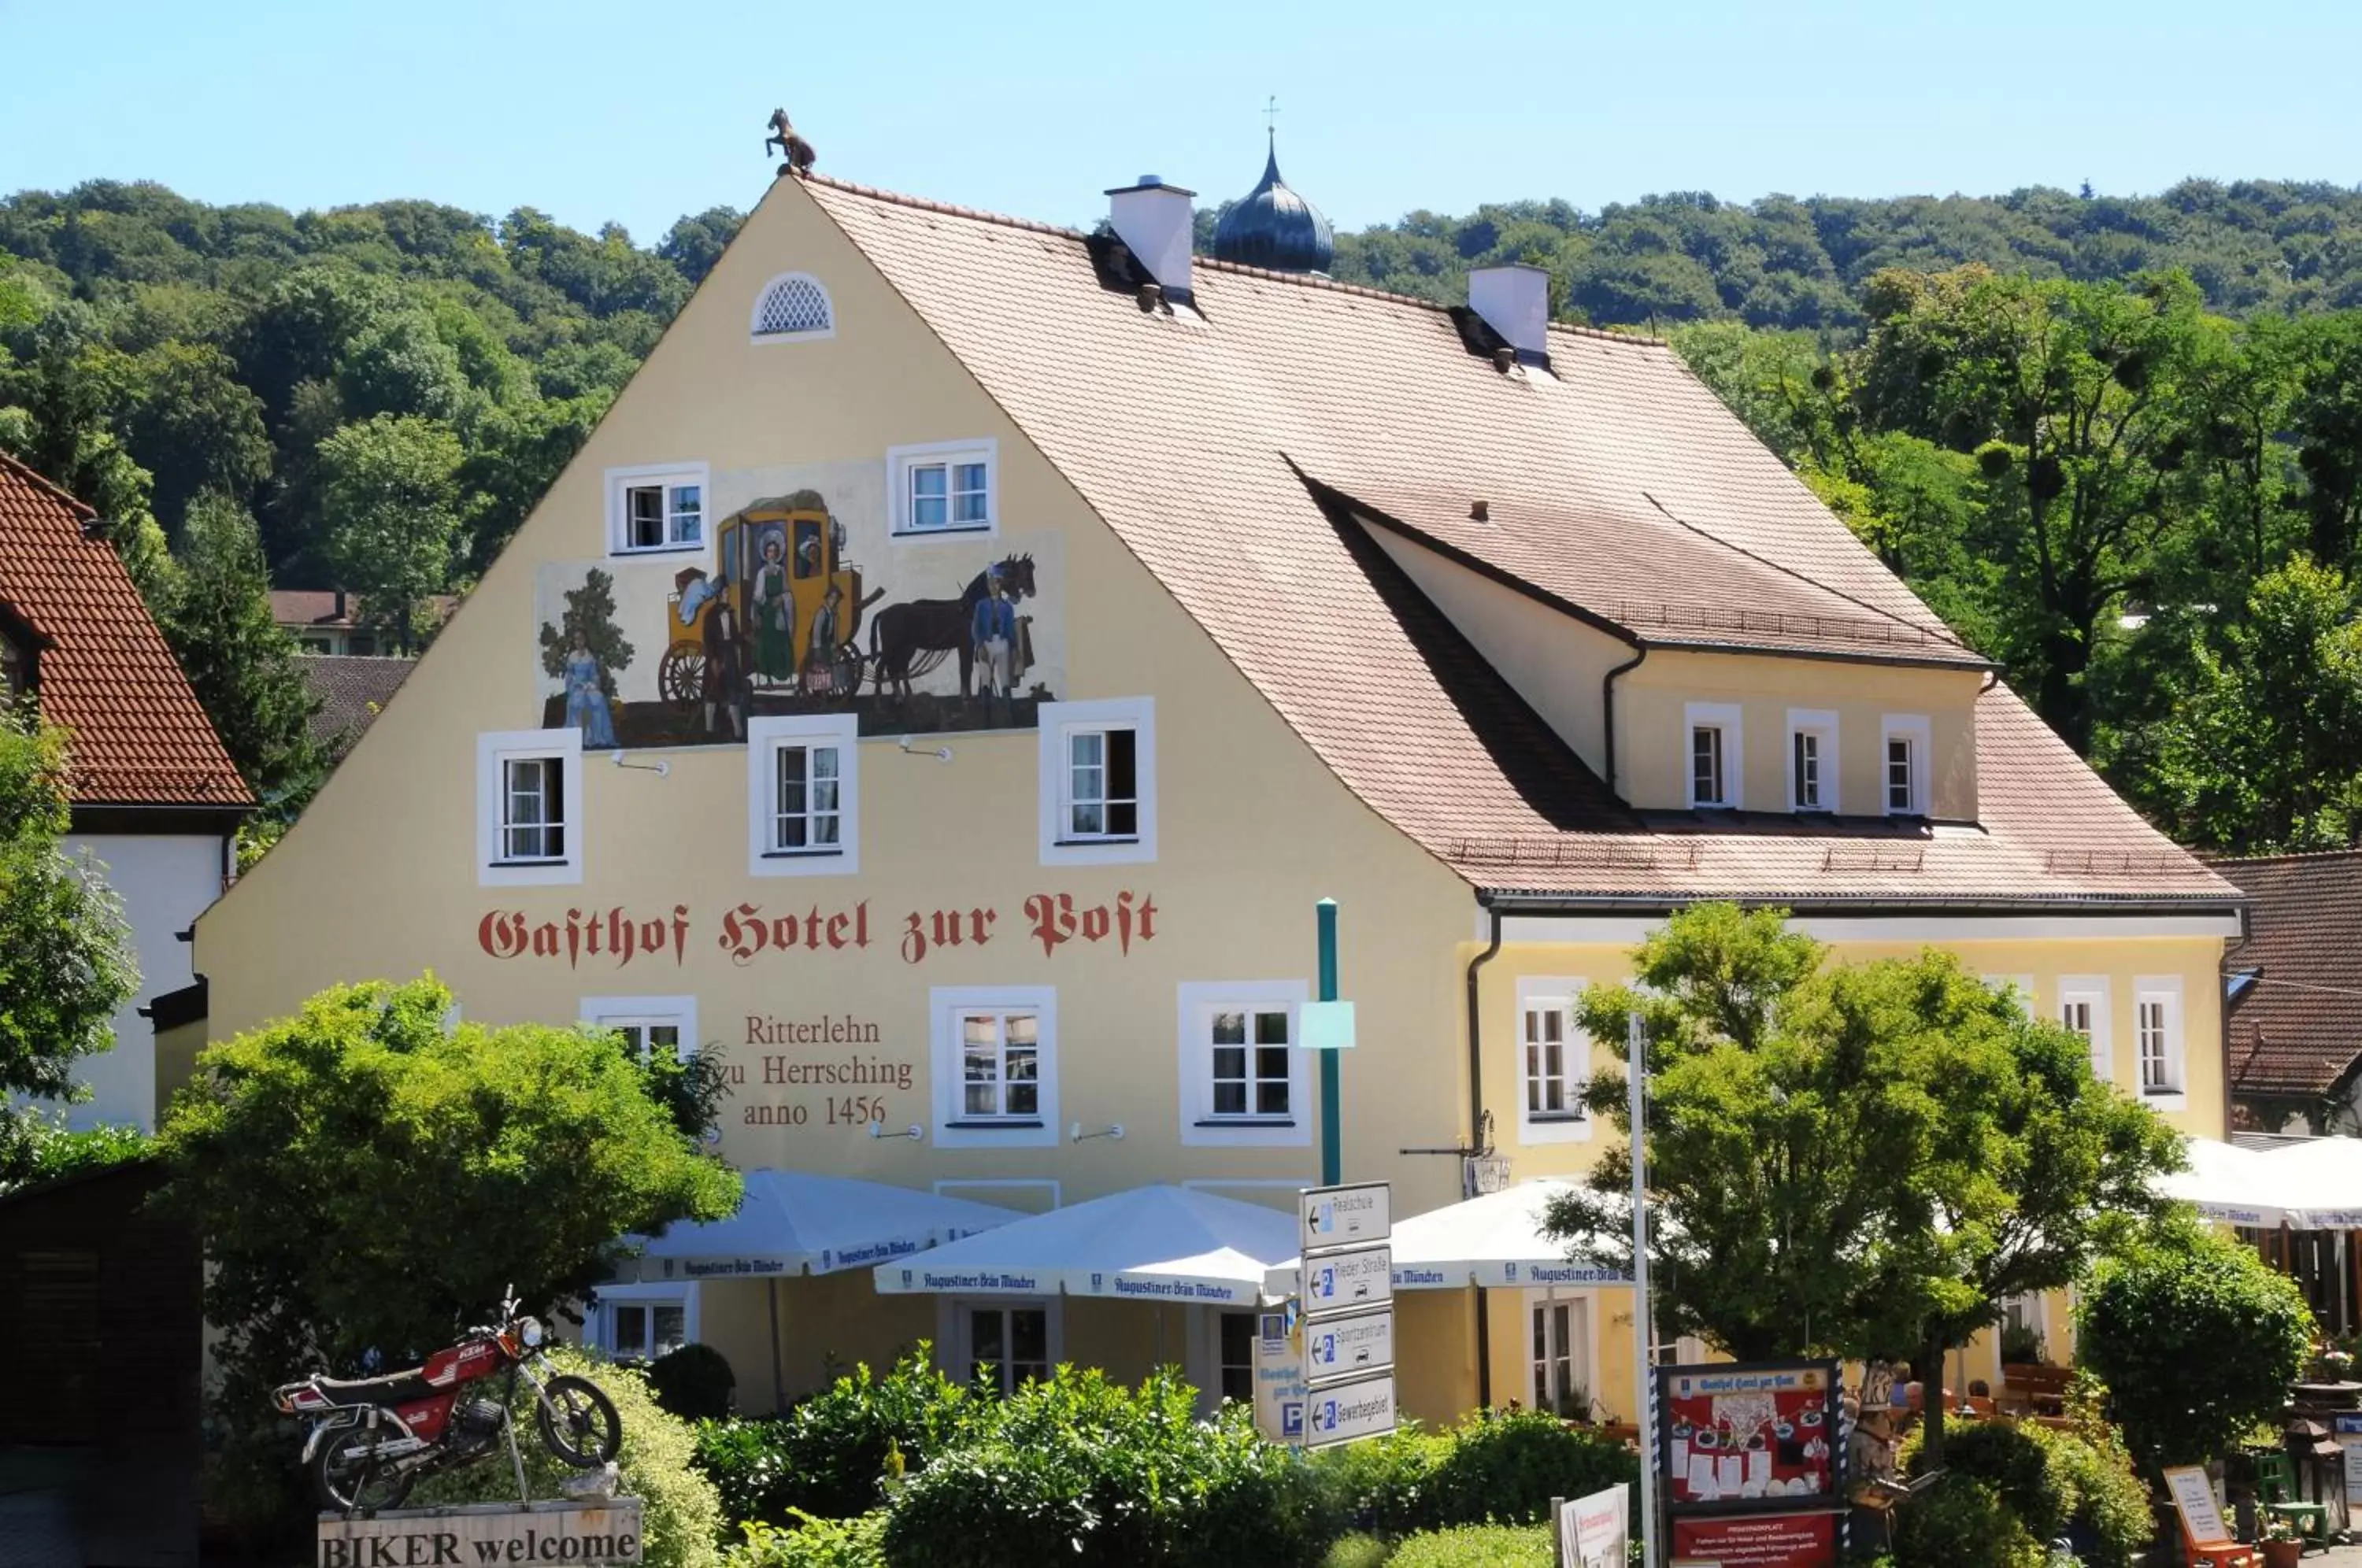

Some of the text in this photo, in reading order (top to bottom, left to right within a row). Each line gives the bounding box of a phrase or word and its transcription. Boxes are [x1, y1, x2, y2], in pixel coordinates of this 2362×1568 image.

[719, 897, 874, 967] Hotel
[901, 908, 997, 963] zur
[746, 1015, 880, 1044] Ritterlehn
[718, 1056, 913, 1090] zu Herrsching
[744, 1096, 886, 1125] anno 1456
[320, 1529, 635, 1568] BIKER welcome
